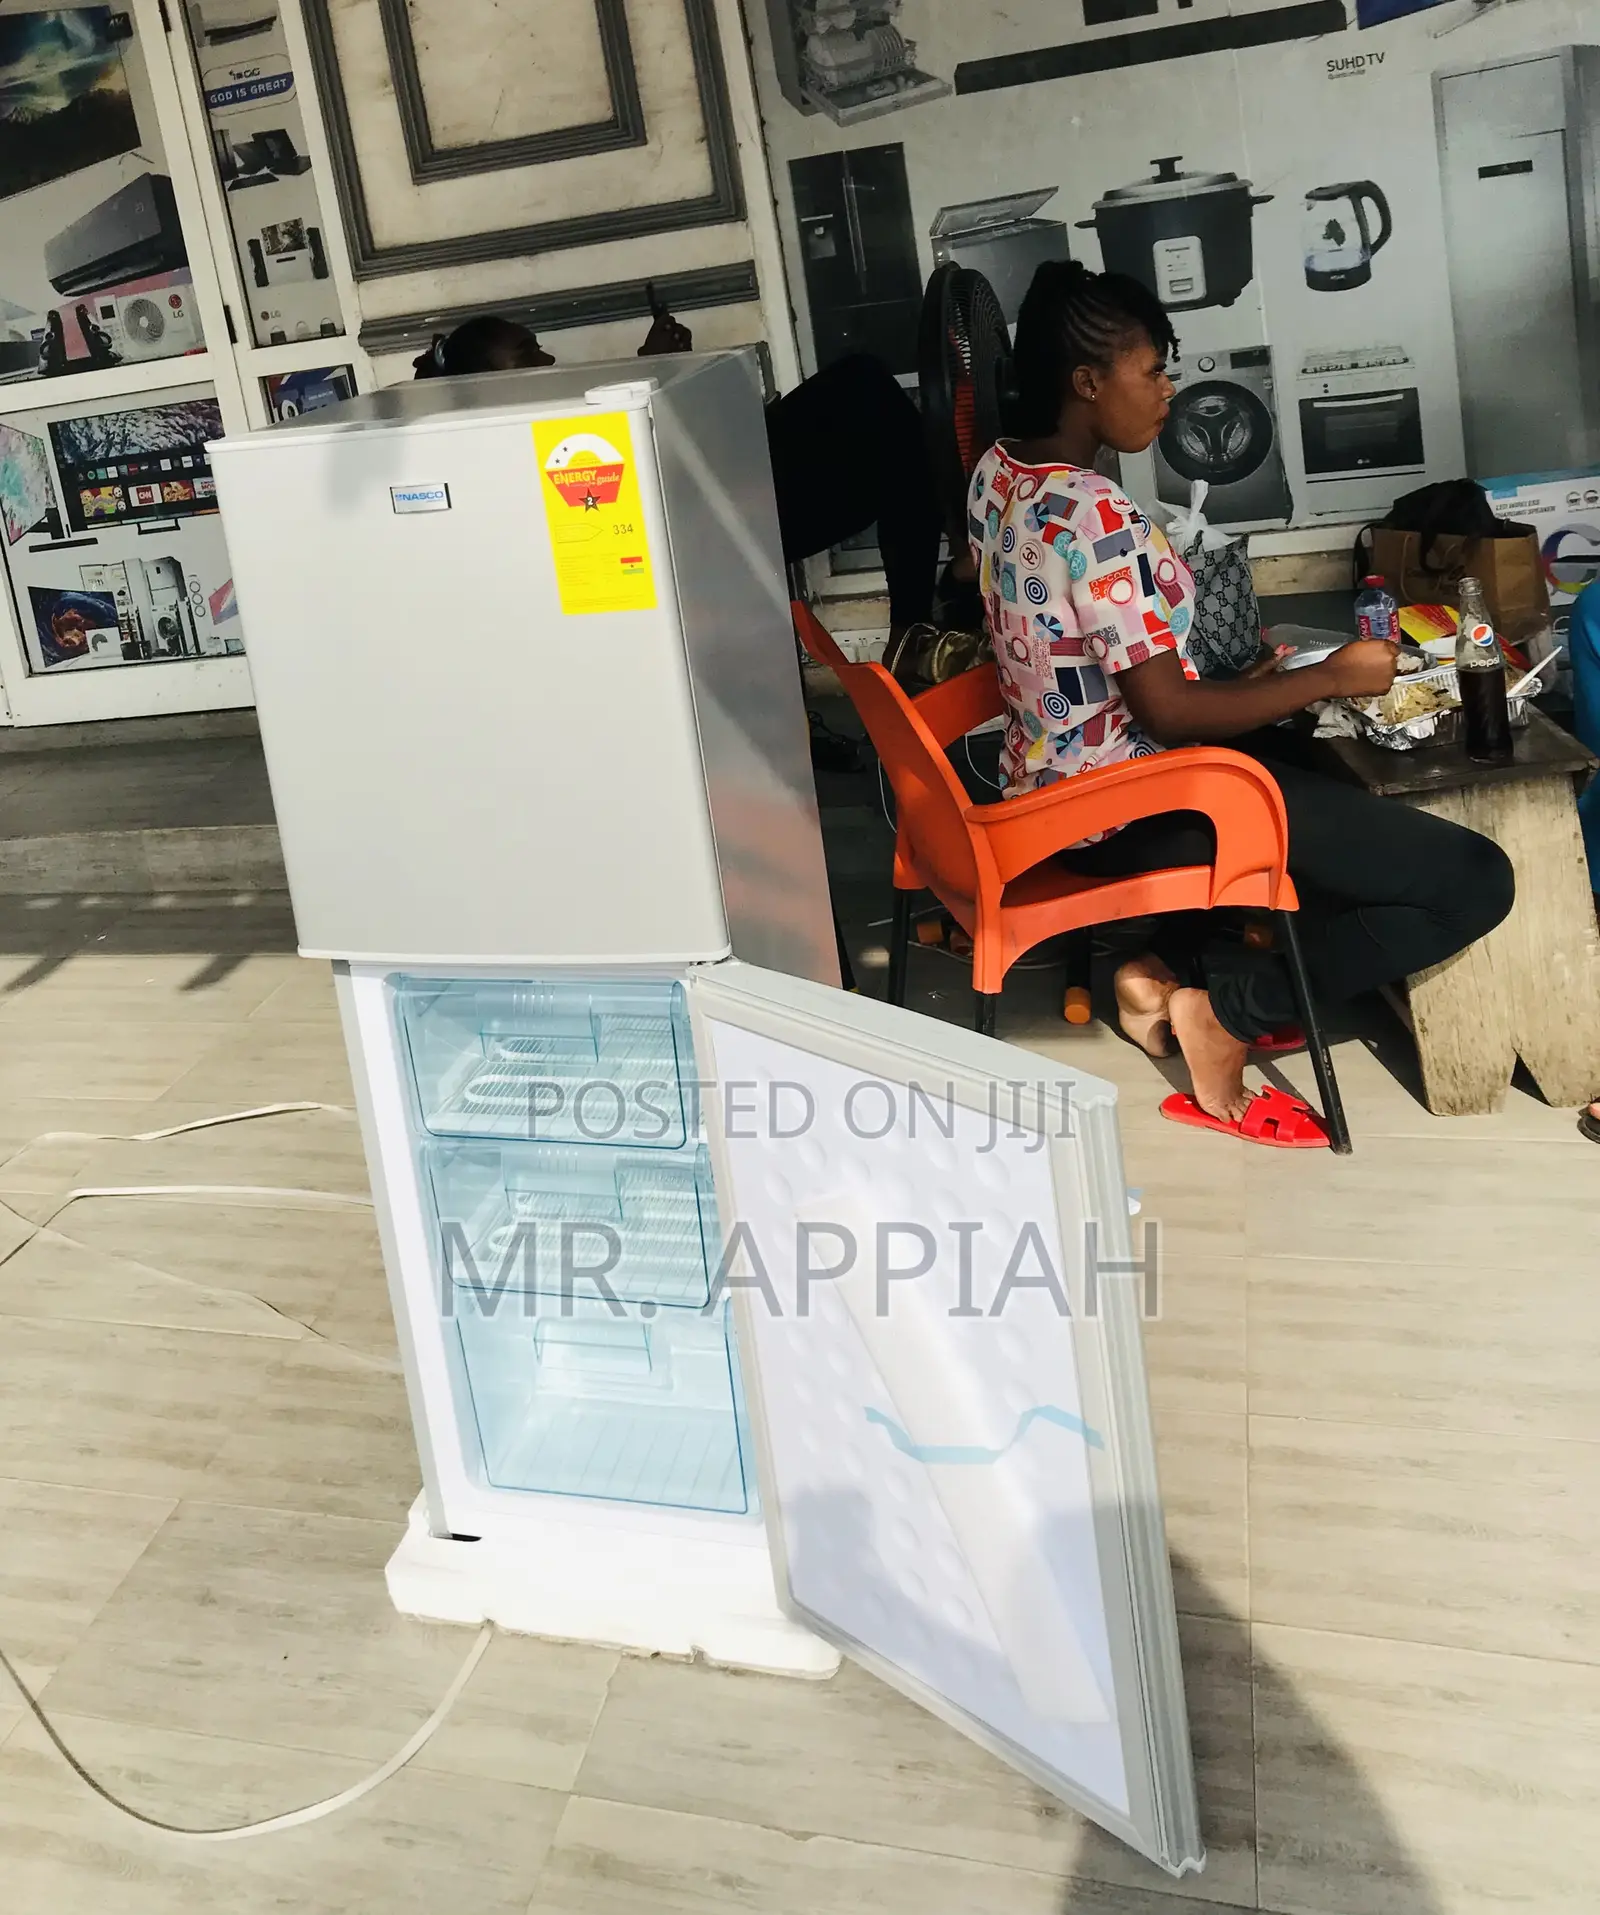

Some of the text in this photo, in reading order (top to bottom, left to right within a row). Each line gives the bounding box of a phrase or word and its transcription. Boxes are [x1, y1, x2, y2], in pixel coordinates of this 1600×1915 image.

[1326, 51, 1385, 73] SUHD TV
[210, 78, 287, 104] GOD IS GREAT
[172, 310, 184, 319] LG
[553, 469, 620, 487] ENERGY guide
[402, 490, 444, 501] NASCO
[587, 497, 594, 506] 2
[612, 523, 634, 536] 334
[1470, 654, 1501, 669] pepsi
